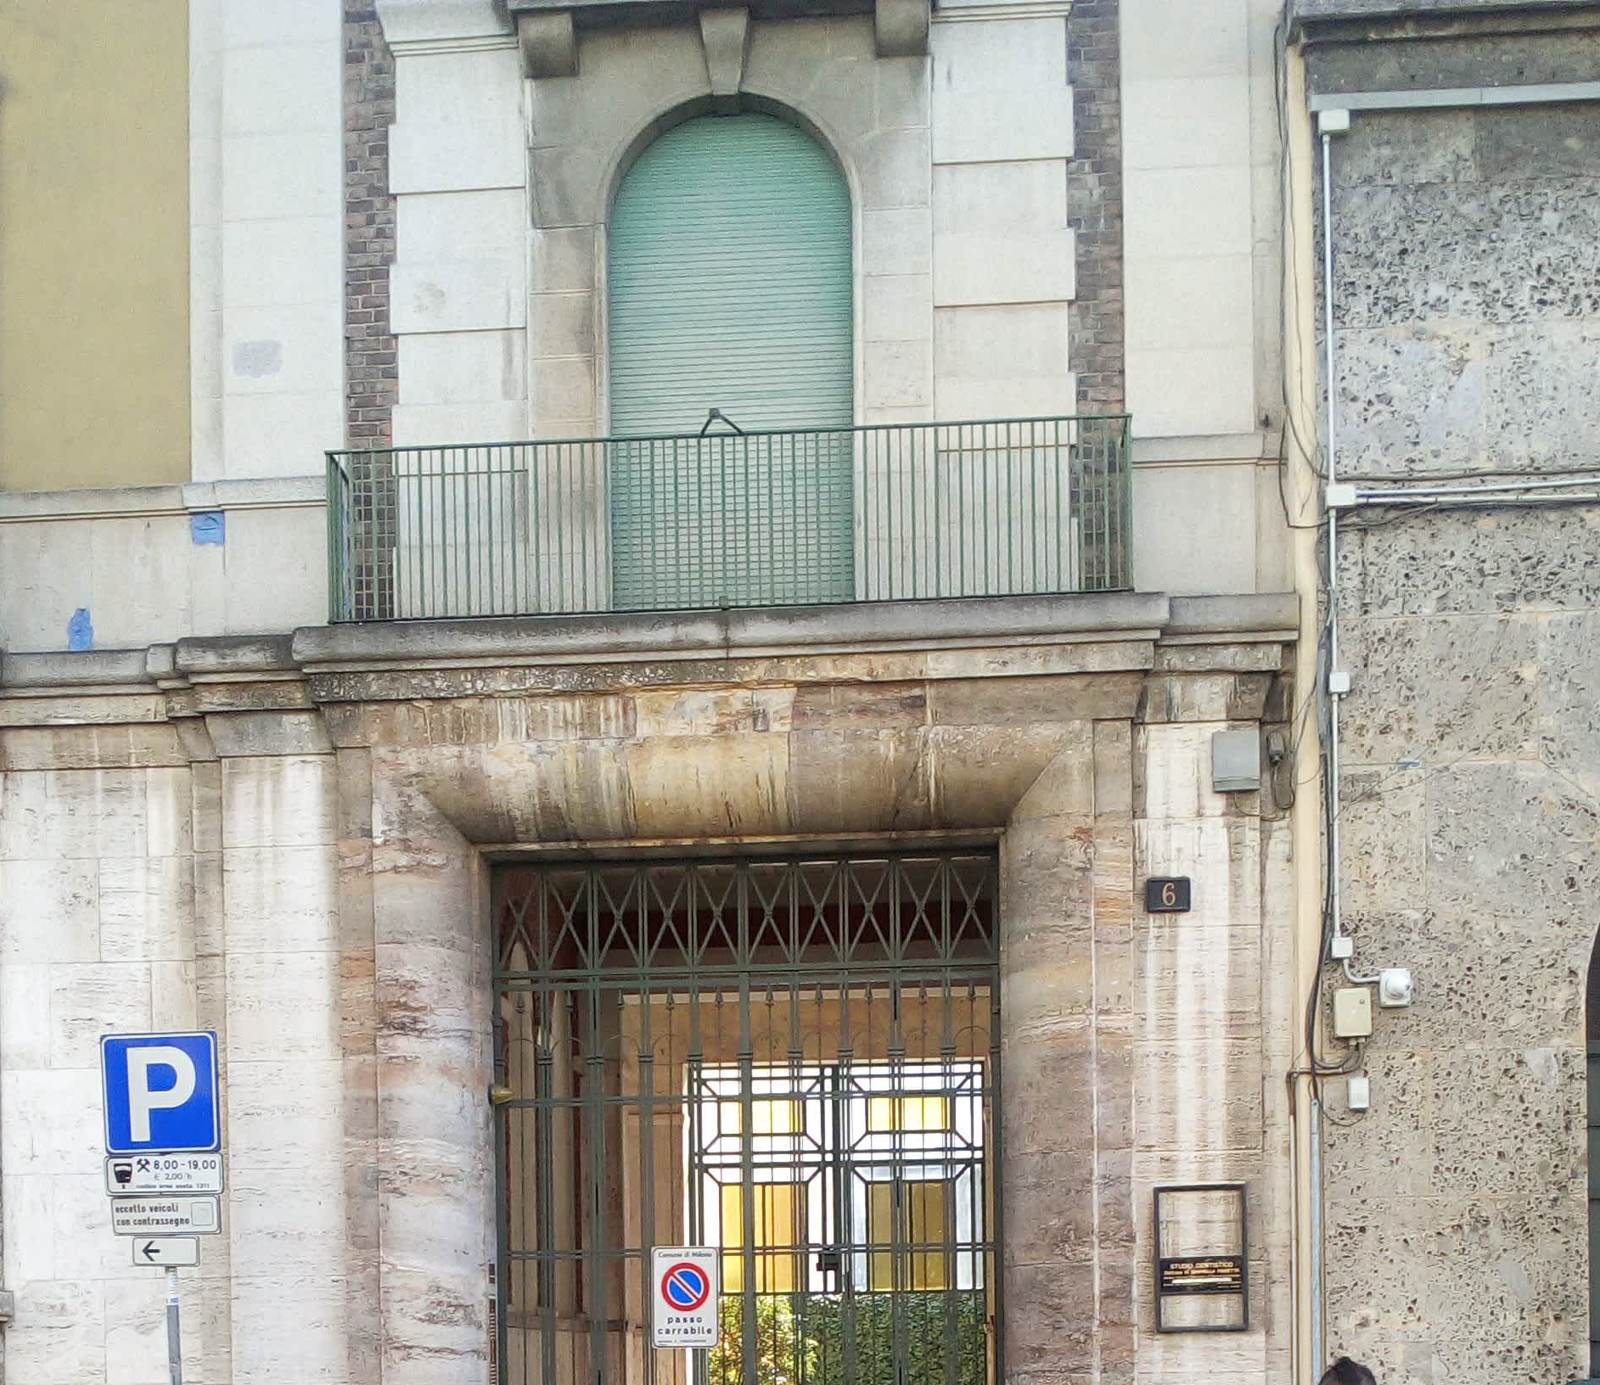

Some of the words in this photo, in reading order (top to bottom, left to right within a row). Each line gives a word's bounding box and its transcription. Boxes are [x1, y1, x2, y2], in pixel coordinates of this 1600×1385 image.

[1162, 882, 1176, 906] 6
[126, 1045, 197, 1143] P
[115, 1203, 147, 1213] eccetto
[149, 1202, 179, 1213] veicoli
[116, 1218, 131, 1226] con
[132, 1216, 190, 1227] contrassegno
[667, 1316, 703, 1325] passo
[657, 1326, 713, 1335] carrabile
